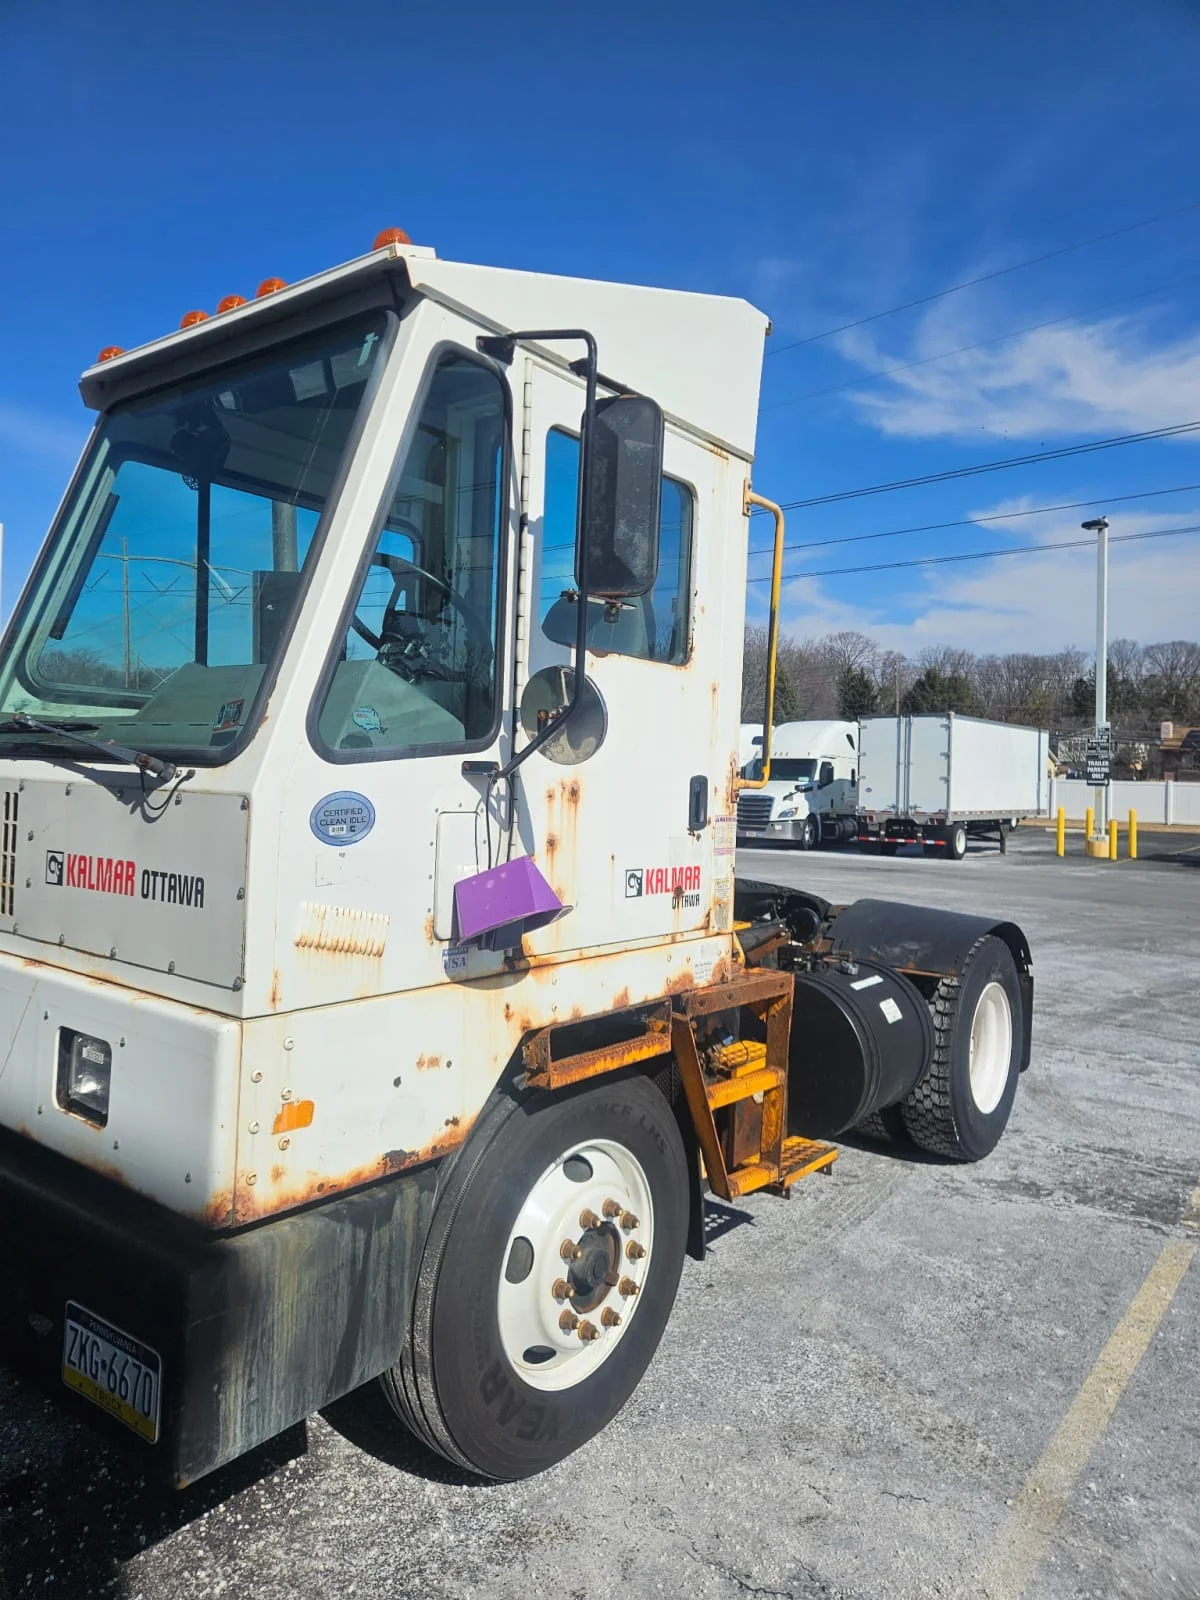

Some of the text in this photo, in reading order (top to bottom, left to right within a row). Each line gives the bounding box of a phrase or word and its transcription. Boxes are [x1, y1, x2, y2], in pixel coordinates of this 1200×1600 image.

[319, 815, 368, 827] CLEAN IDLE
[323, 808, 363, 817] CERTIFIED
[66, 853, 205, 909] KALMAR OTTAWA
[645, 865, 701, 896] KALMAR
[671, 893, 700, 910] OTTAWA
[444, 956, 467, 970] USA
[89, 1319, 137, 1354] PENNSYLVANIA
